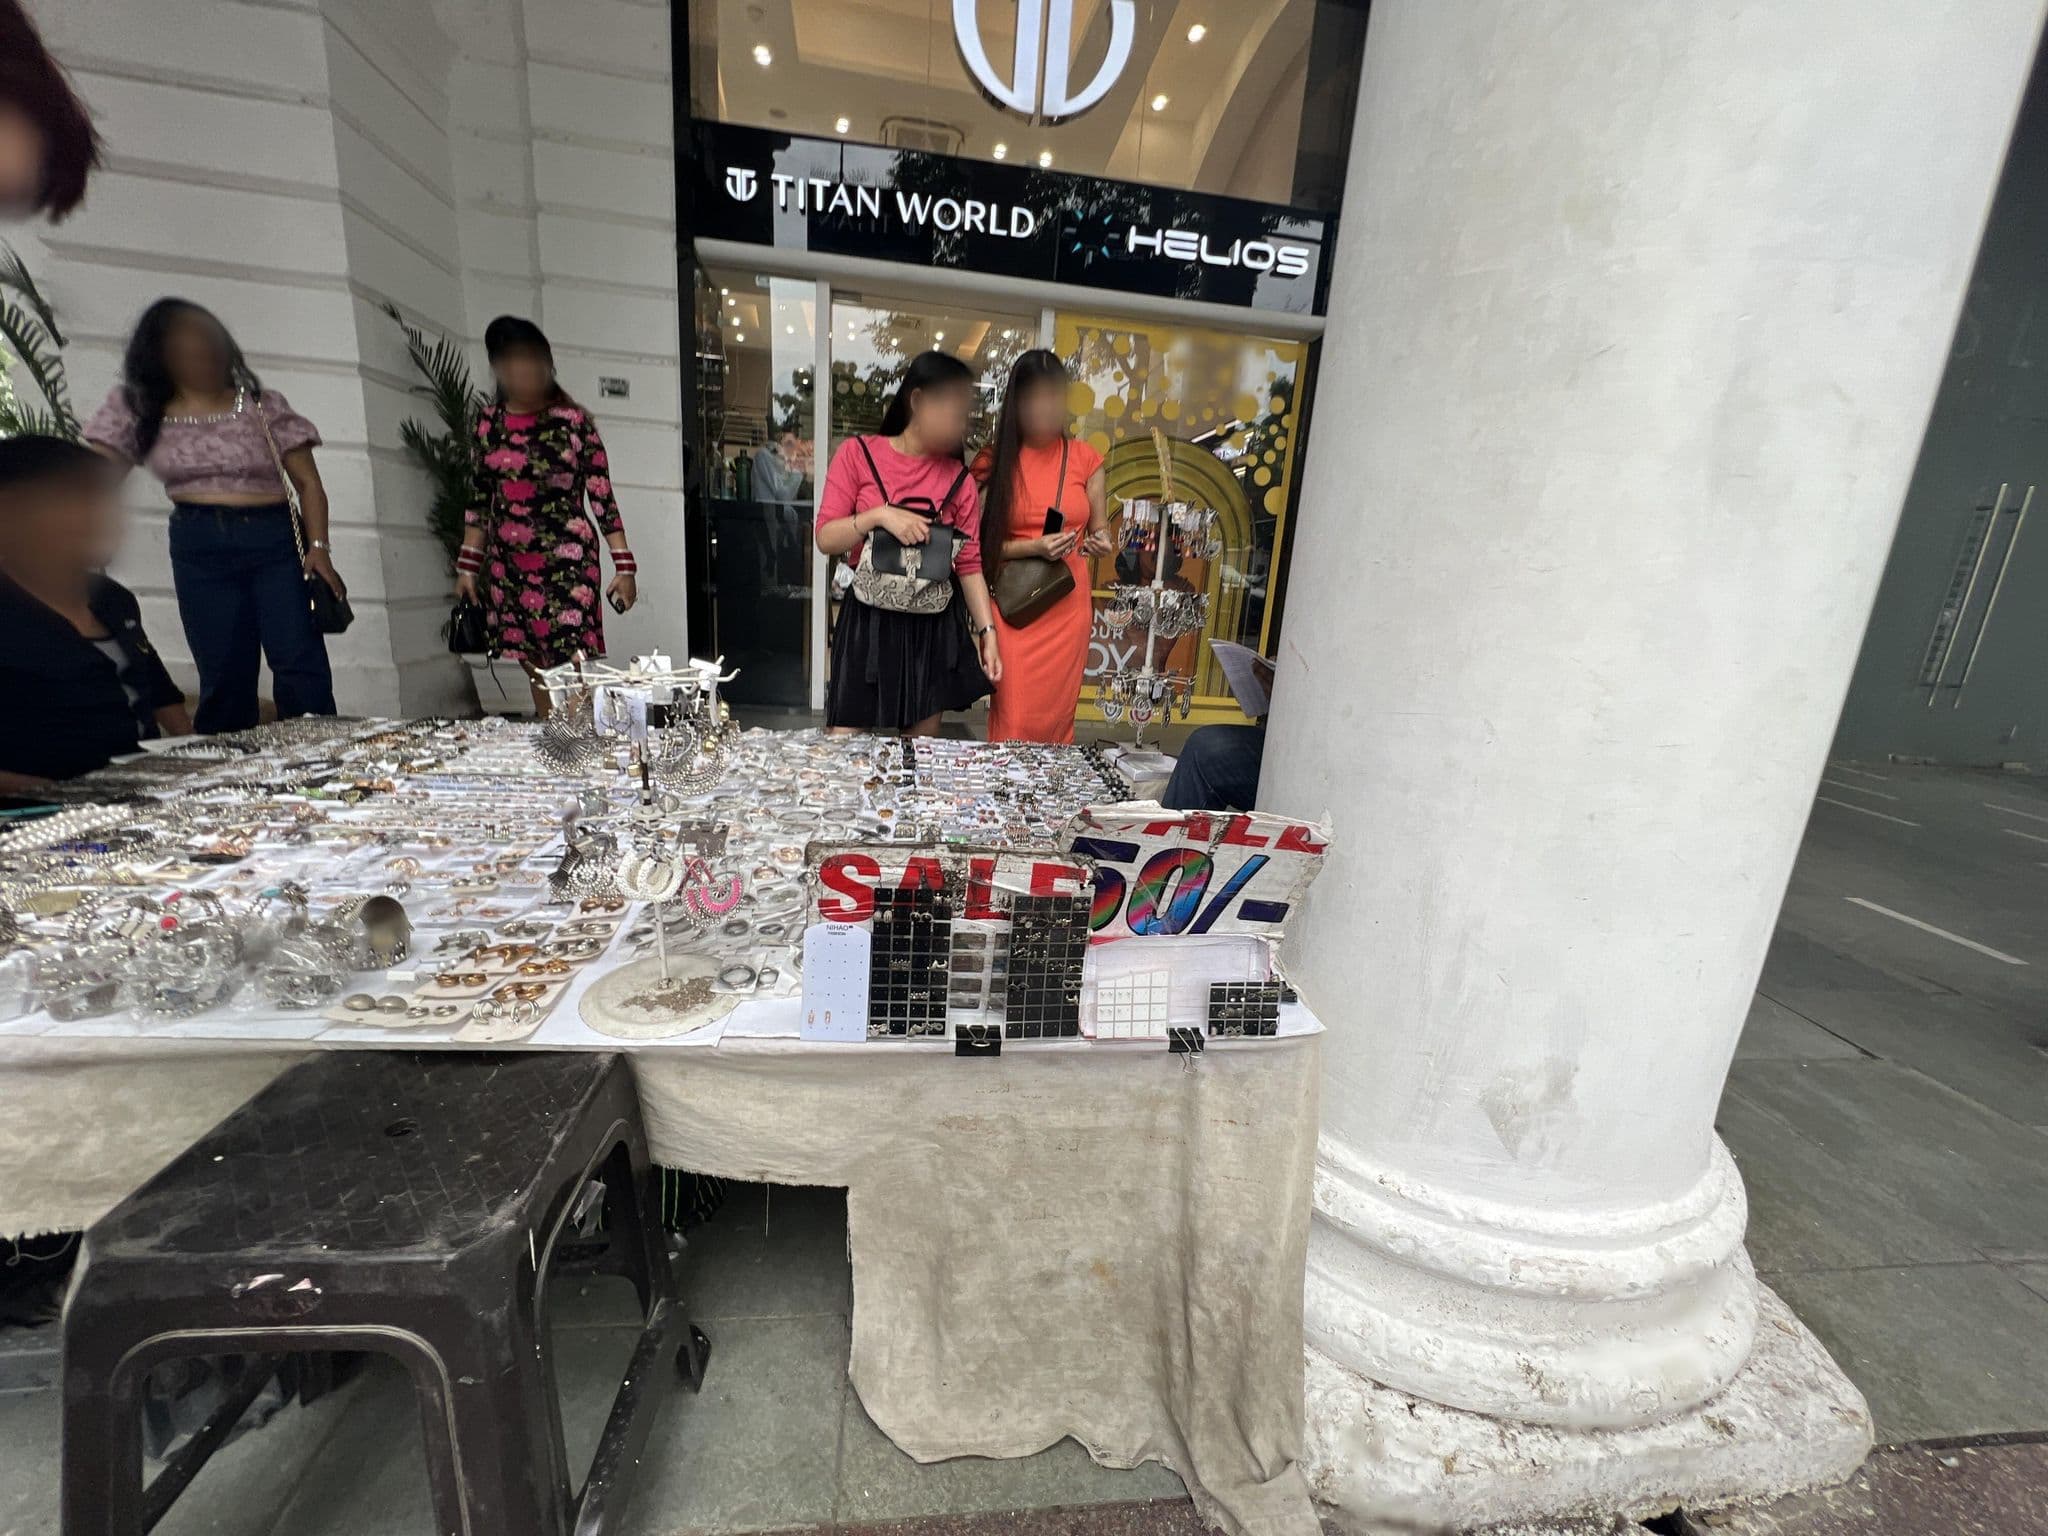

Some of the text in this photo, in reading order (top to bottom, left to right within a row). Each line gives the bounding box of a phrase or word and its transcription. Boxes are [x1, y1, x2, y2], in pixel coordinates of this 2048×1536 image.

[771, 173, 880, 219] TITAN
[895, 190, 1035, 238] WORLD
[1128, 225, 1309, 275] HELIOS
